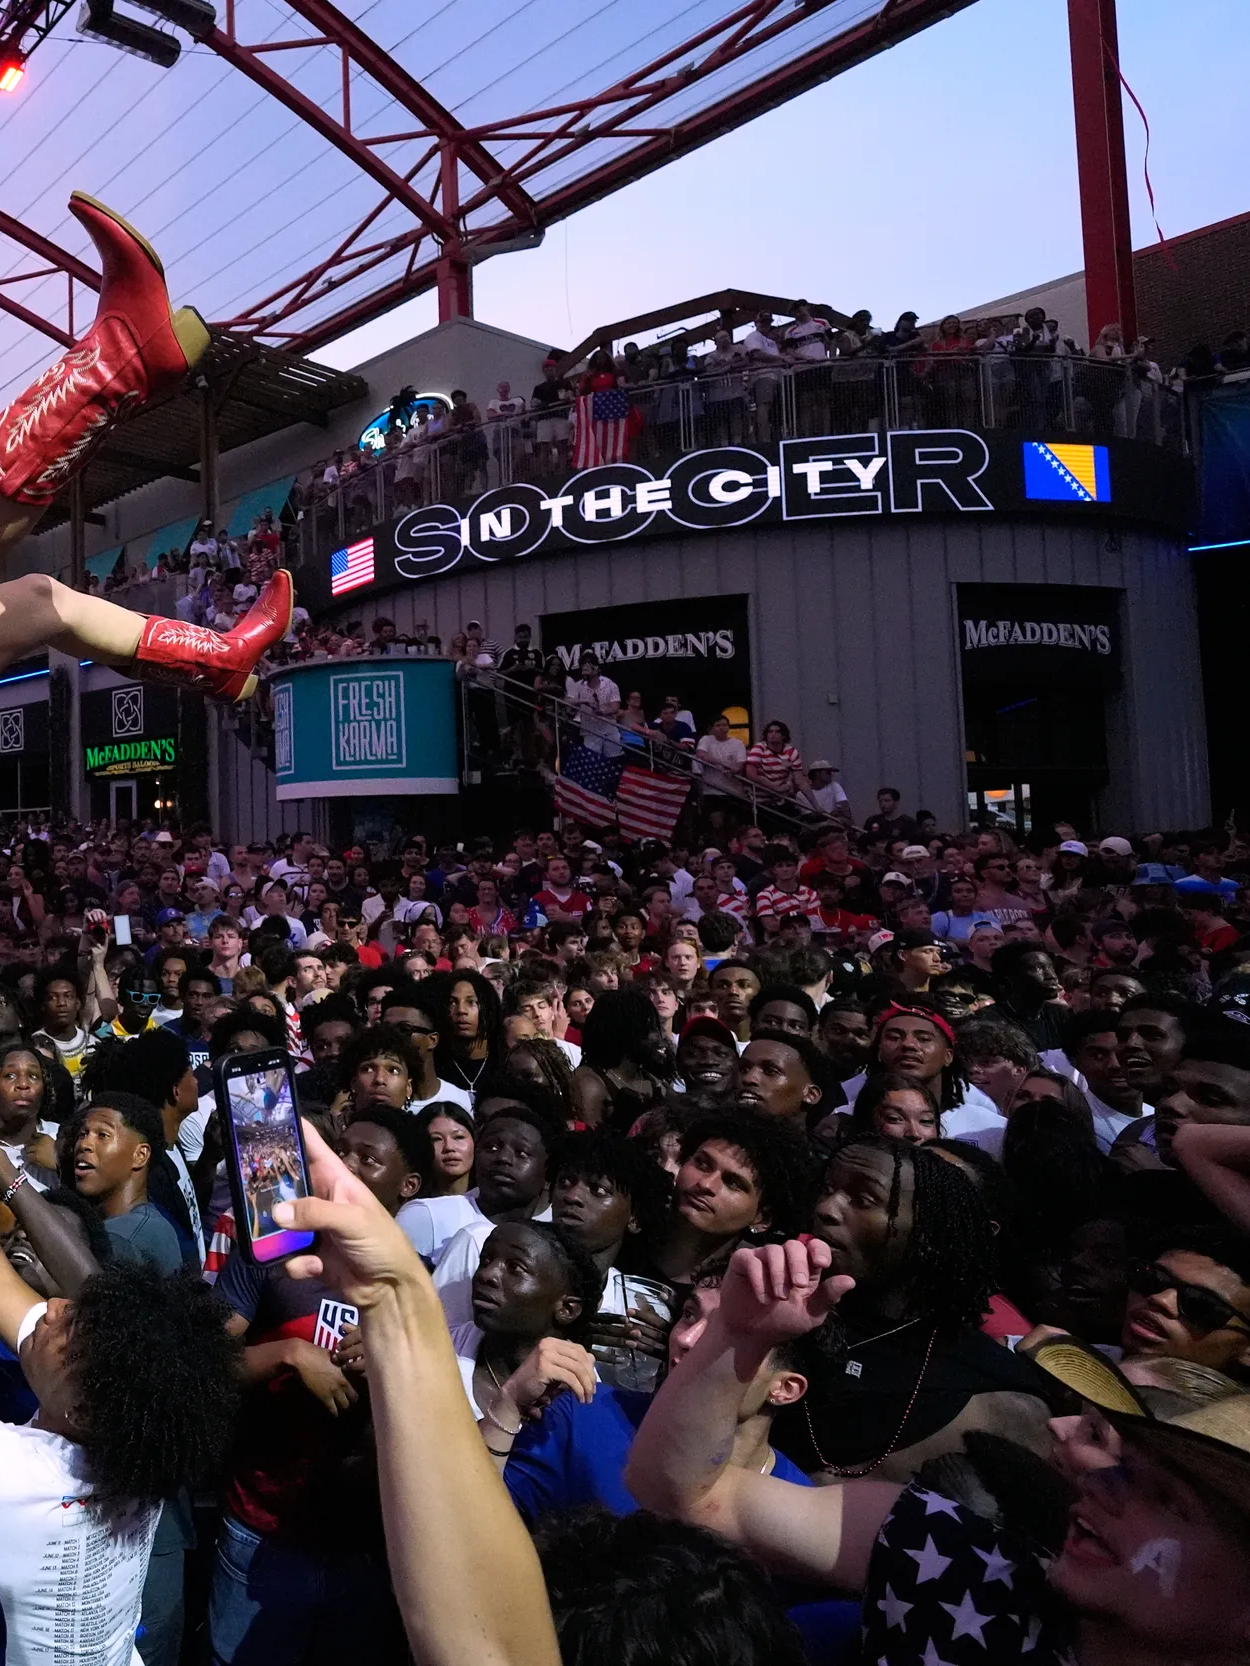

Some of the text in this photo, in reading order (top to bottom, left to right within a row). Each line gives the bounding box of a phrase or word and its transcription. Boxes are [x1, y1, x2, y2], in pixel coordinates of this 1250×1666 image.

[394, 428, 995, 578] SOCCER
[460, 456, 887, 546] IN THE CITY
[556, 629, 736, 671] MFADDEN'S
[963, 619, 1111, 655] McFADDEN'S
[338, 680, 397, 721] FRESH
[86, 738, 175, 771] McFADDEN'S
[339, 720, 398, 762] KARMA
[322, 1304, 356, 1337] US
